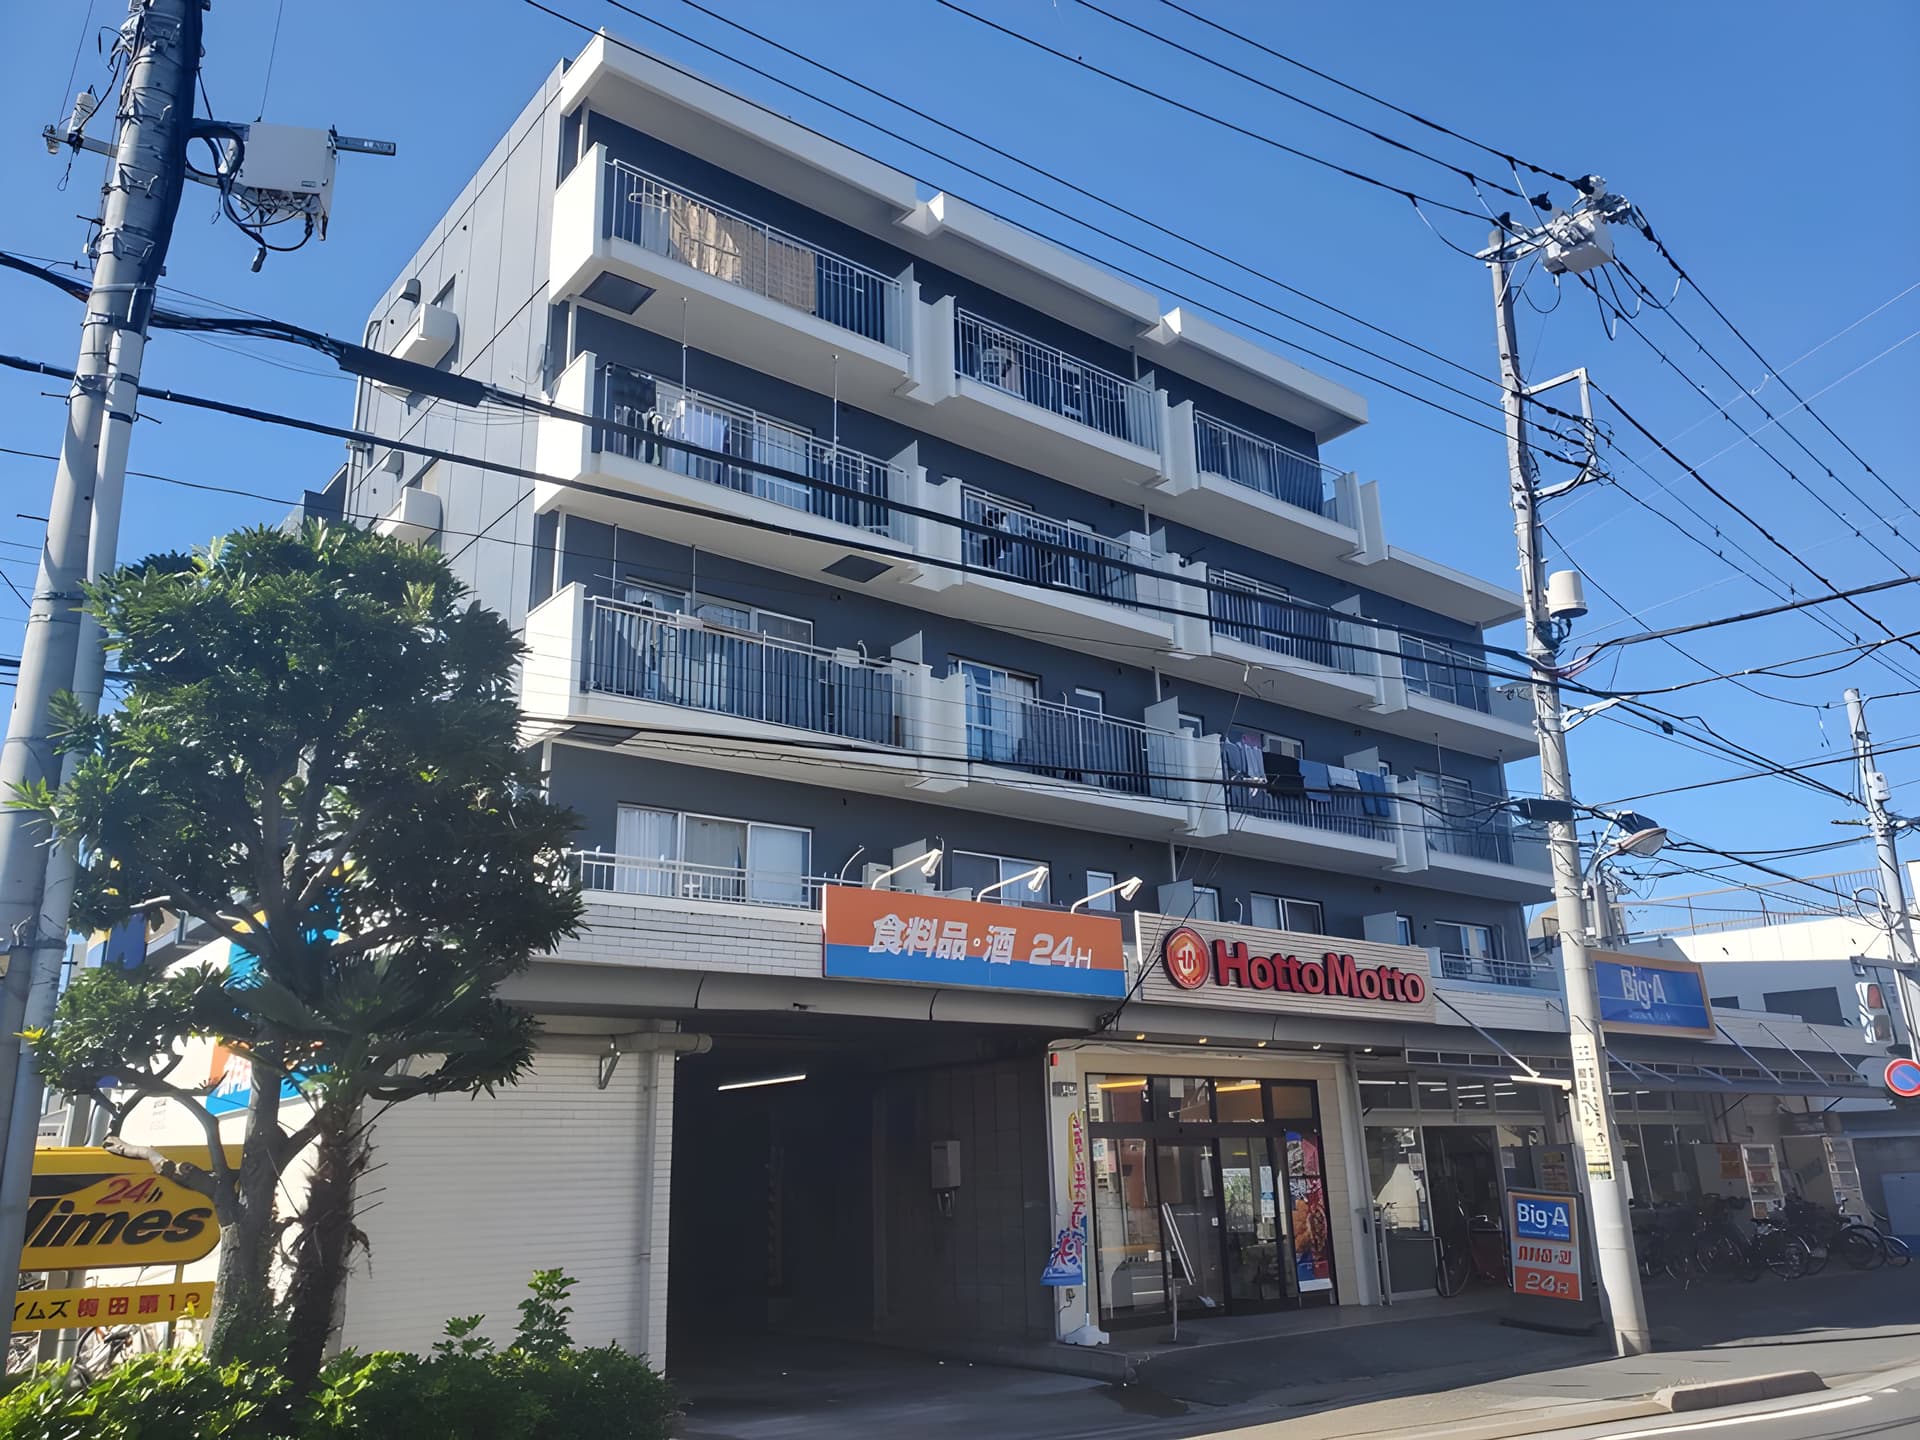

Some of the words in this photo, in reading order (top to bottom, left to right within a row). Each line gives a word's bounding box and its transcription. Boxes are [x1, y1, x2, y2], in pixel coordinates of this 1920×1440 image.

[868, 913, 1017, 965] 食料品・酒
[1029, 933, 1092, 970] 24H
